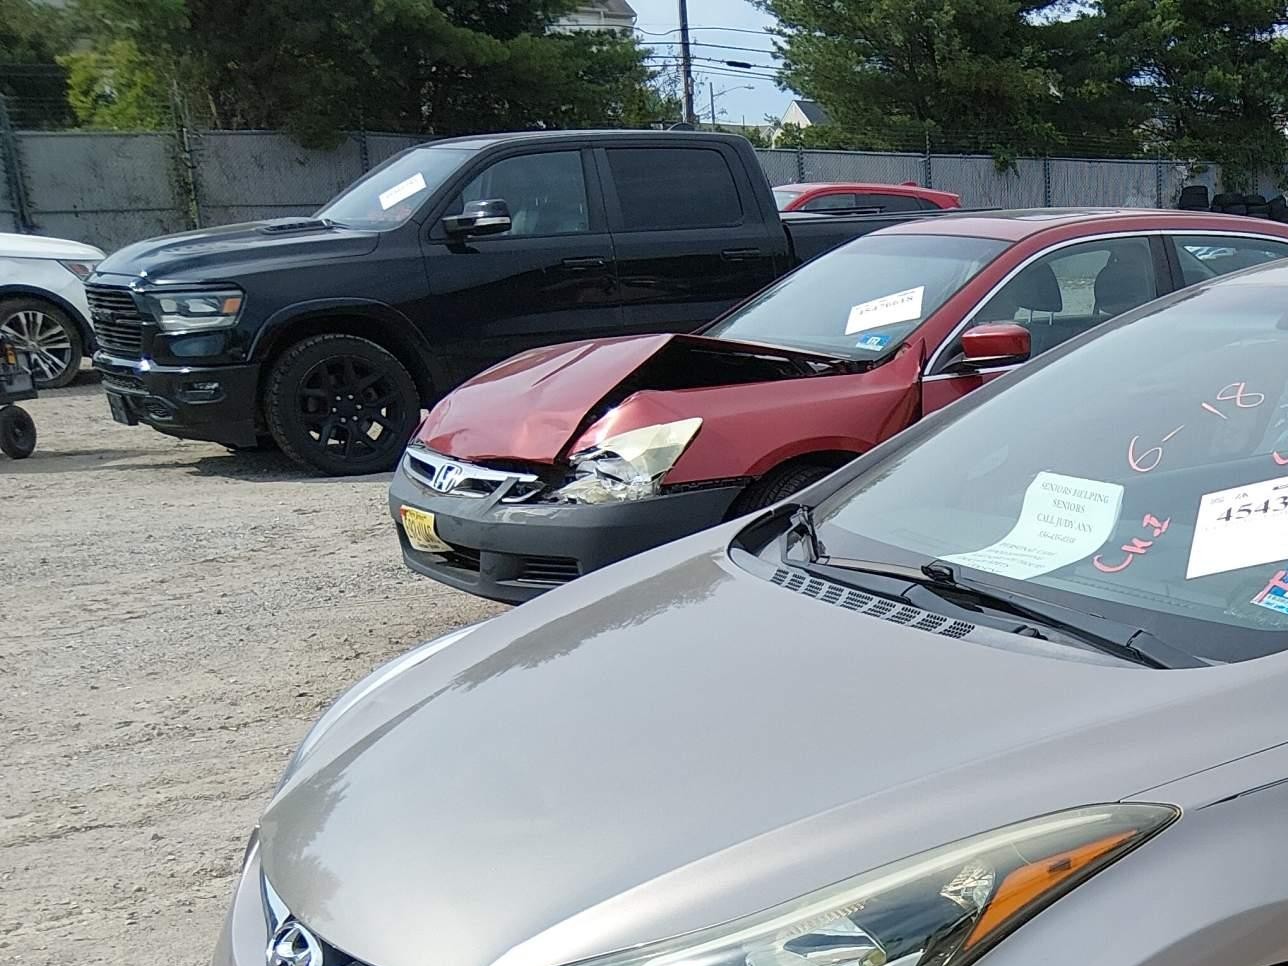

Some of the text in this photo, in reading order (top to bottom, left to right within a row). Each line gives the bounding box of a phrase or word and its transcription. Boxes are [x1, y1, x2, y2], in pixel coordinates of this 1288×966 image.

[1071, 487, 1110, 504] HELPING
[1052, 498, 1086, 514] SENIORS
[1036, 512, 1094, 534] CALL JUDY ANN
